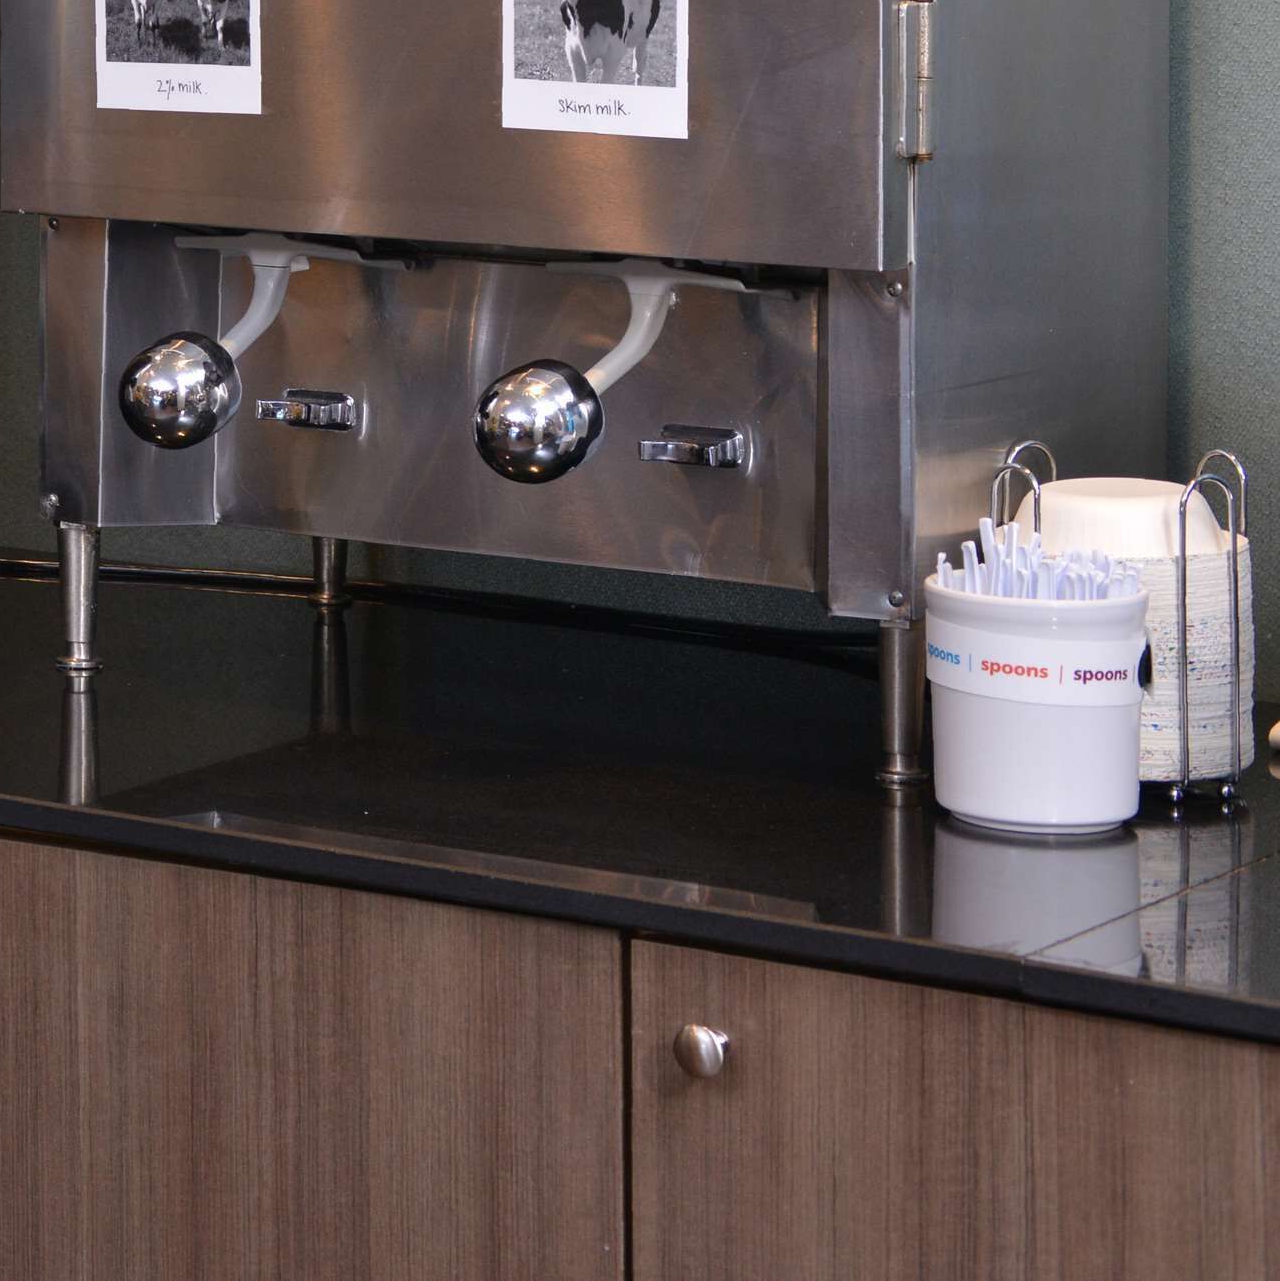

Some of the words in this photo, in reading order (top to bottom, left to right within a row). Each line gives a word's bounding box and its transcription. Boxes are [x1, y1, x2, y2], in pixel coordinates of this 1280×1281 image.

[156, 79, 175, 100] 2%
[981, 657, 1049, 679] spoons
[1073, 667, 1129, 685] spoons
